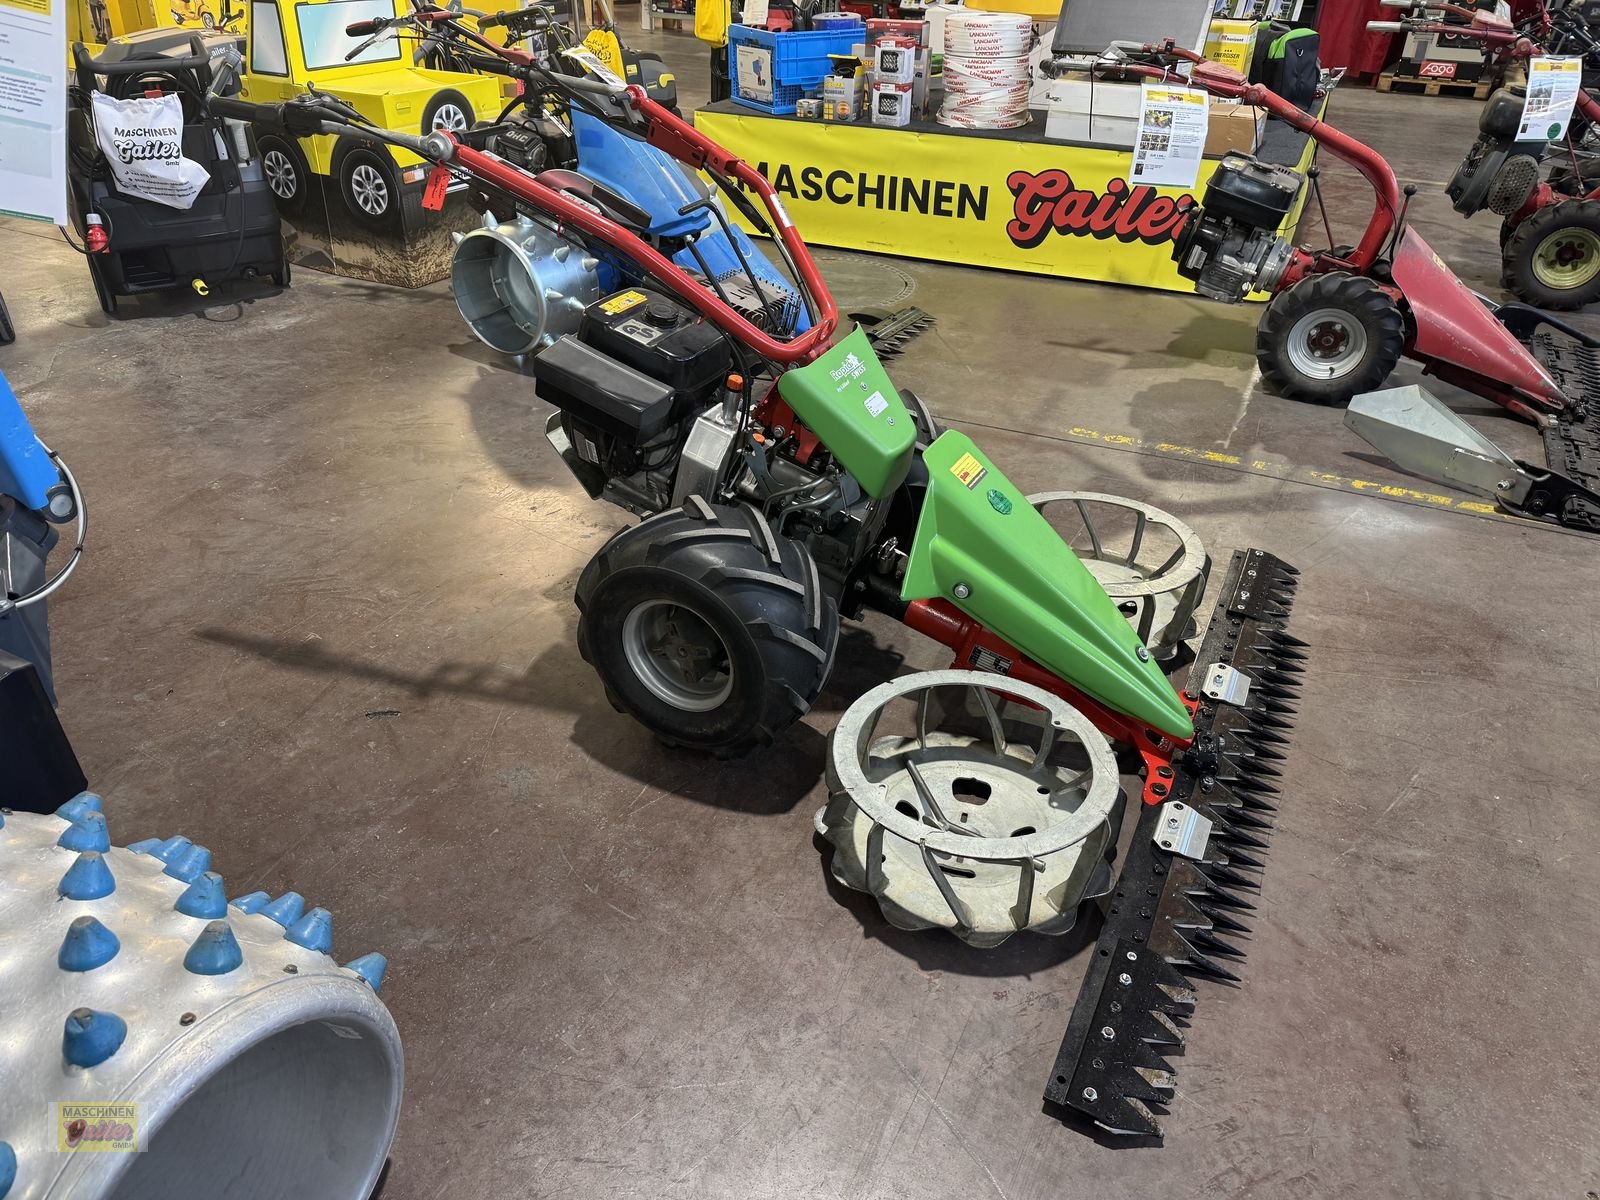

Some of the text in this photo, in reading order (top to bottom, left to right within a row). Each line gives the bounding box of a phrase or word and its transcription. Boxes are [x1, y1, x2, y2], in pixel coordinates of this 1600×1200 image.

[114, 127, 178, 138] MASCHINEN
[505, 129, 529, 143] OHC
[114, 140, 181, 164] Gailer
[622, 324, 655, 340] GS
[829, 358, 856, 382] Rapid
